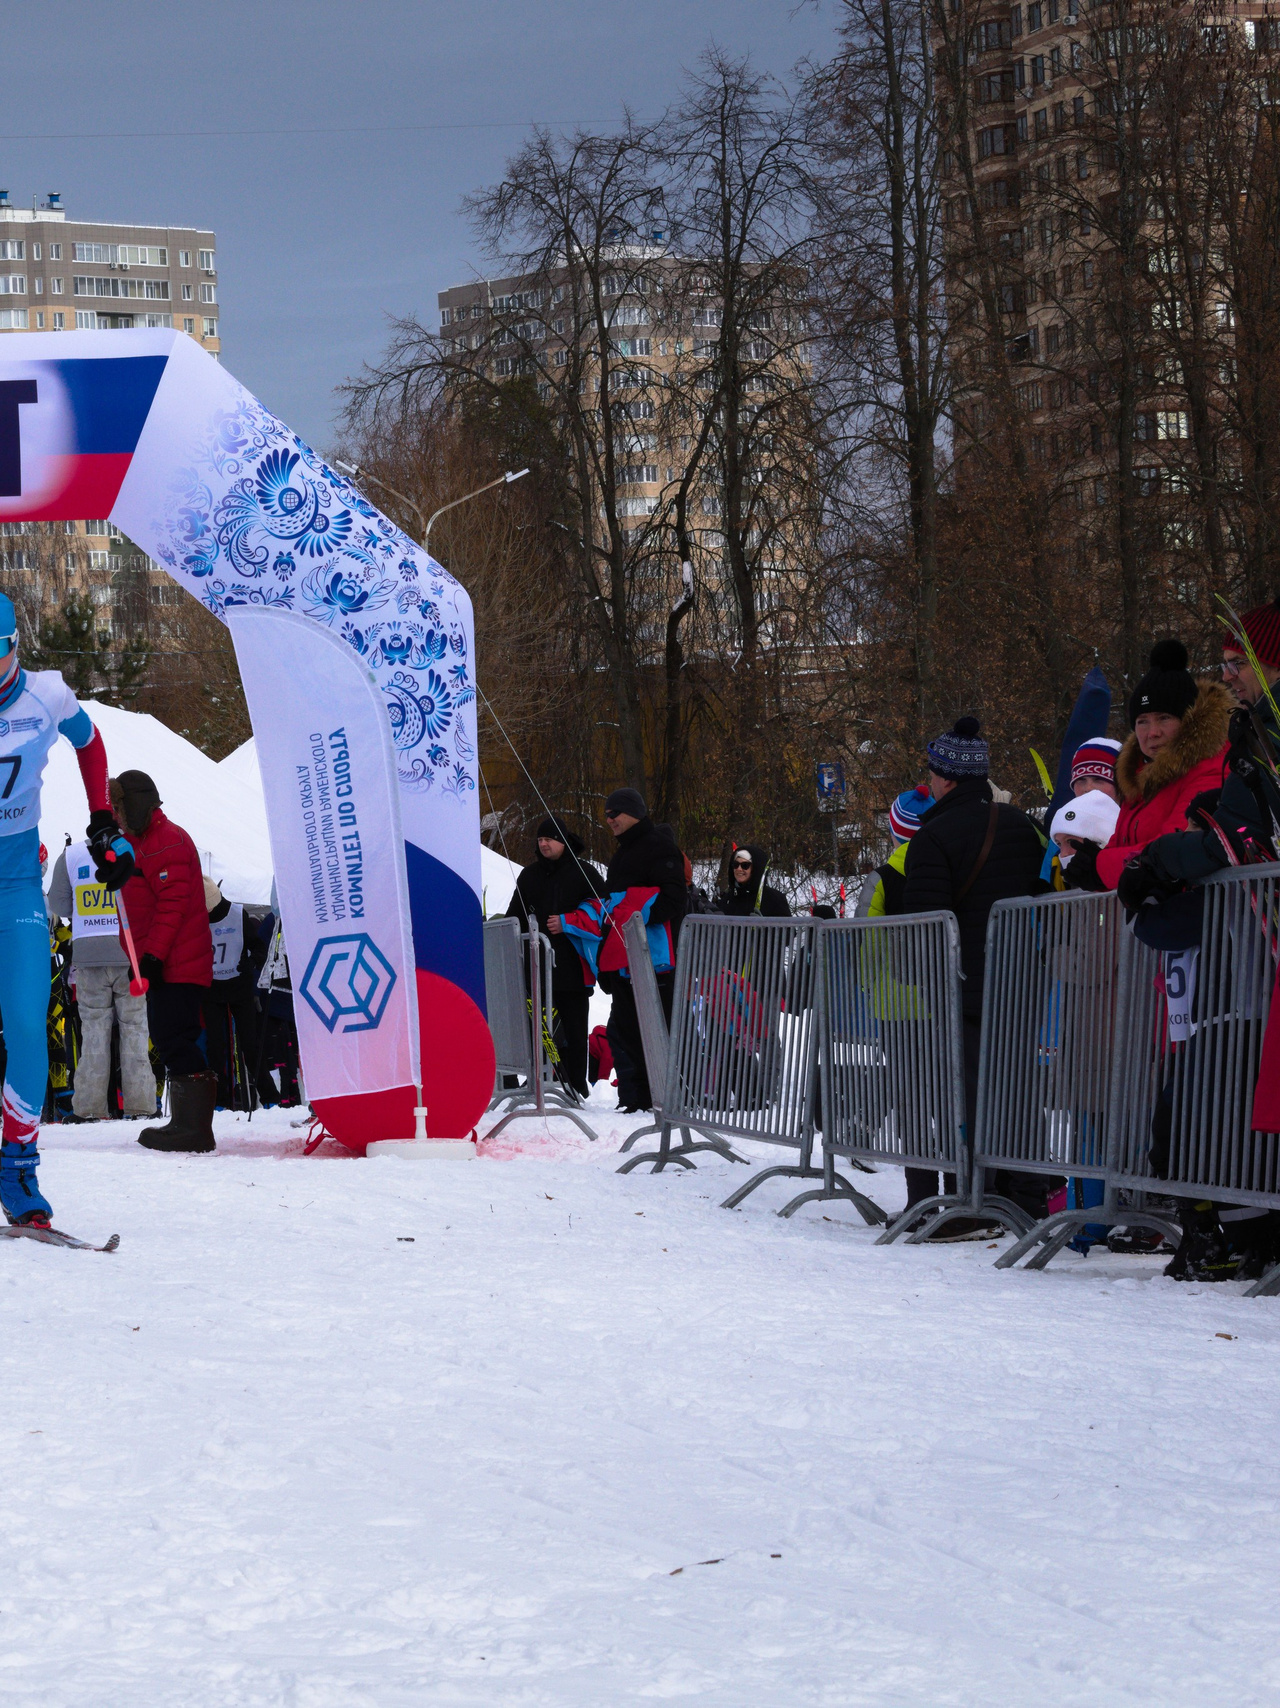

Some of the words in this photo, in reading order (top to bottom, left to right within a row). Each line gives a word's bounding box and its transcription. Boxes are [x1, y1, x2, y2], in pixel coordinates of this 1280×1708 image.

[1072, 764, 1114, 779] РОССИ
[83, 889, 117, 909] СУД
[84, 917, 119, 927] РАМЕНС
[213, 967, 235, 976] ЕНСКОЕ
[1166, 952, 1187, 999] 5
